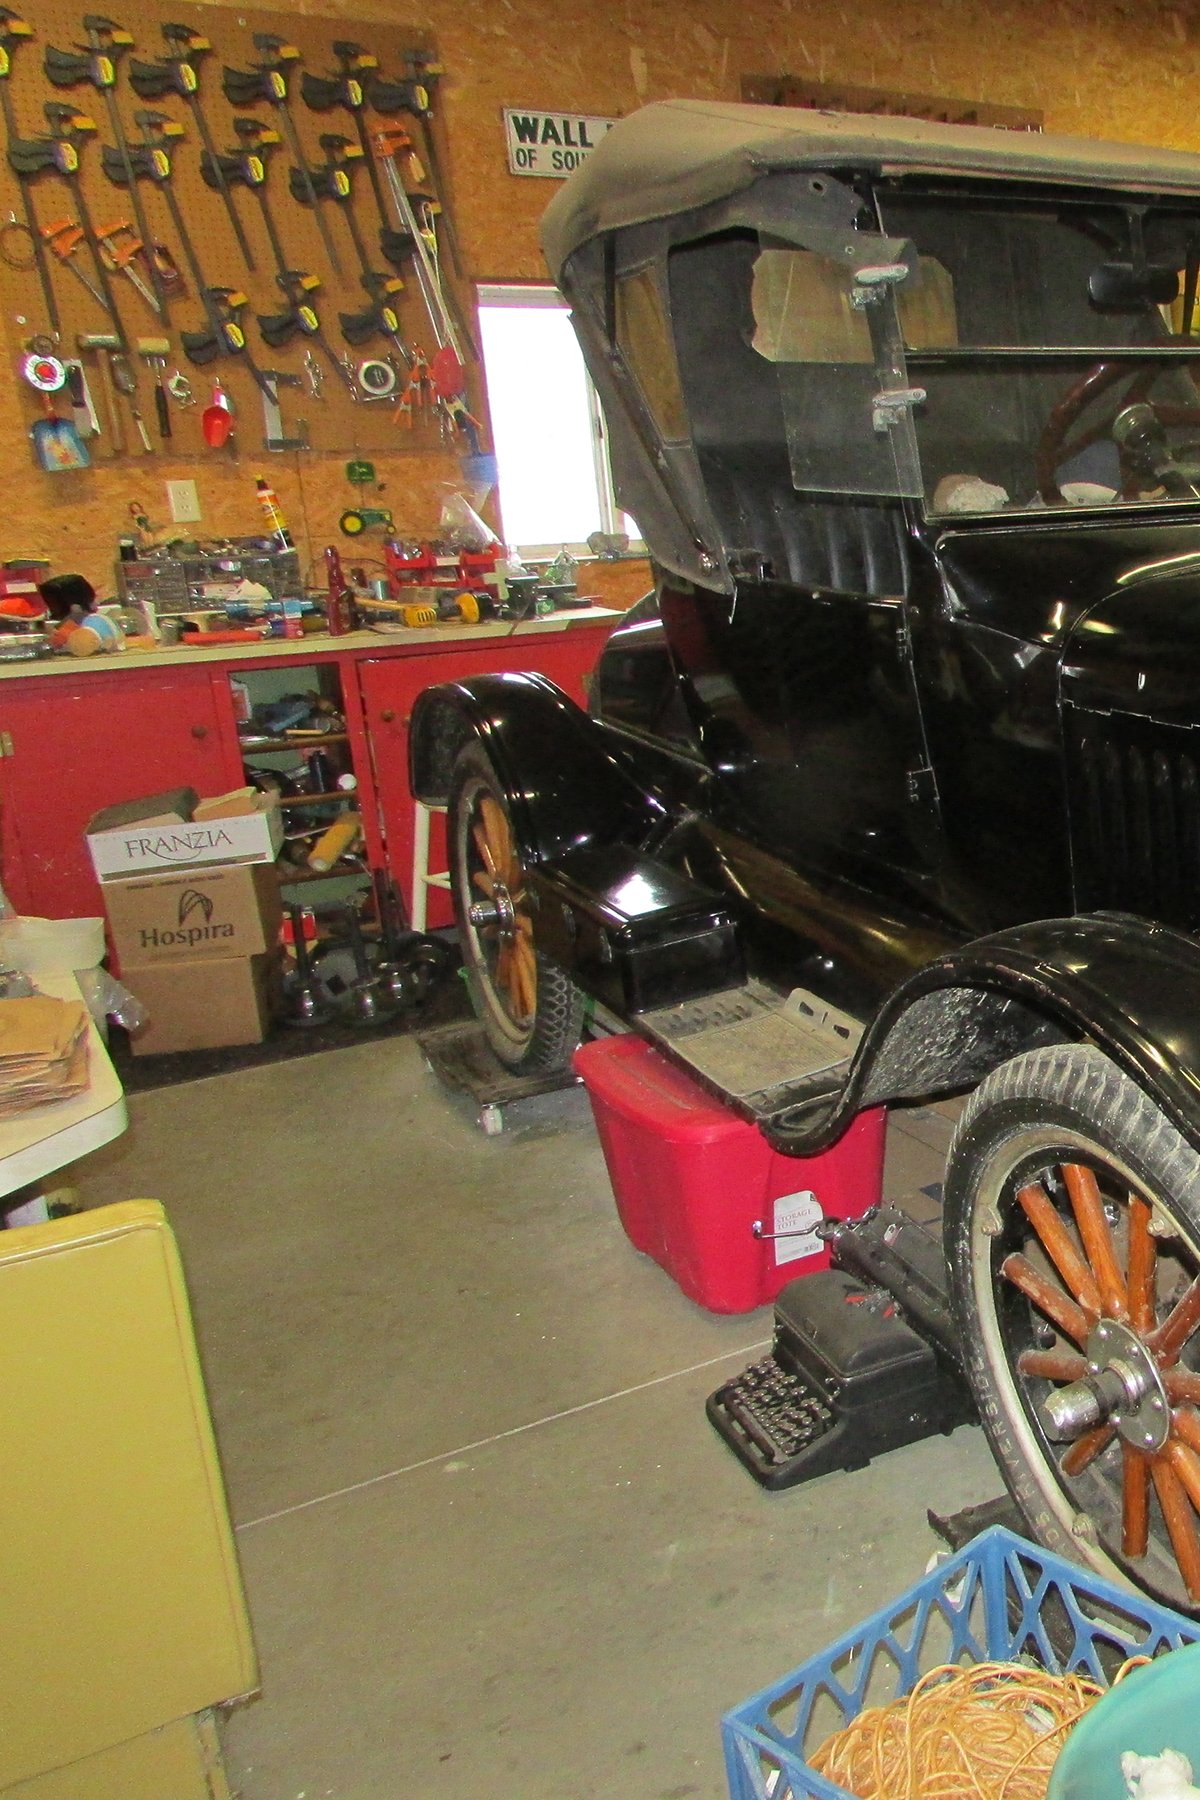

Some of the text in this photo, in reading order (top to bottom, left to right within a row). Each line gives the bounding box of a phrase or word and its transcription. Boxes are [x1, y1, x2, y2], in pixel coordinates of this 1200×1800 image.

[511, 115, 595, 148] WALL
[515, 148, 538, 169] OF
[124, 829, 233, 861] FRANZIA
[138, 922, 236, 948] Hospira
